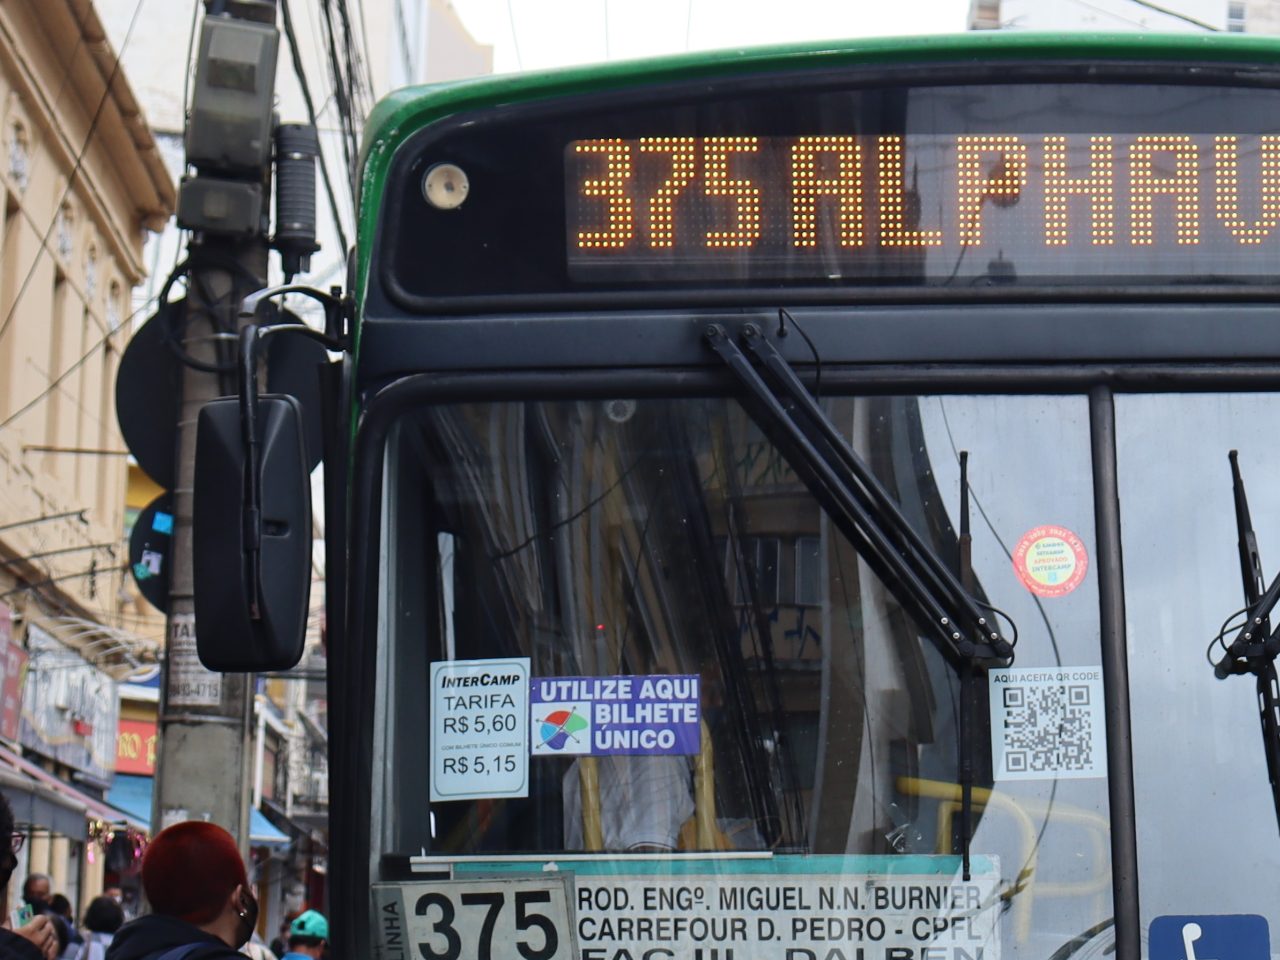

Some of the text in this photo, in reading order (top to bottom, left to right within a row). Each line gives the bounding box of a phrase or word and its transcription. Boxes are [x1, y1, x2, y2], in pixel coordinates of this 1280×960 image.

[575, 136, 761, 248] 375
[994, 671, 1100, 683] AQUI ACEITA QR CODE
[540, 678, 698, 701] UTILIZE AQUI
[444, 694, 515, 711] TARIFA
[595, 703, 697, 724] BILHETE
[443, 714, 516, 735] R$ 5,60
[595, 724, 675, 750] ÚNICO
[443, 754, 516, 775] R$ 5,15
[578, 887, 635, 911] ROD.
[719, 886, 811, 911] MIGUEL
[819, 886, 866, 911] N.N.
[875, 885, 982, 911] BURNIER
[578, 917, 747, 942] CARREFOUR
[757, 917, 781, 941] D.
[792, 917, 886, 941] PEDRO
[912, 916, 982, 941] CPFL
